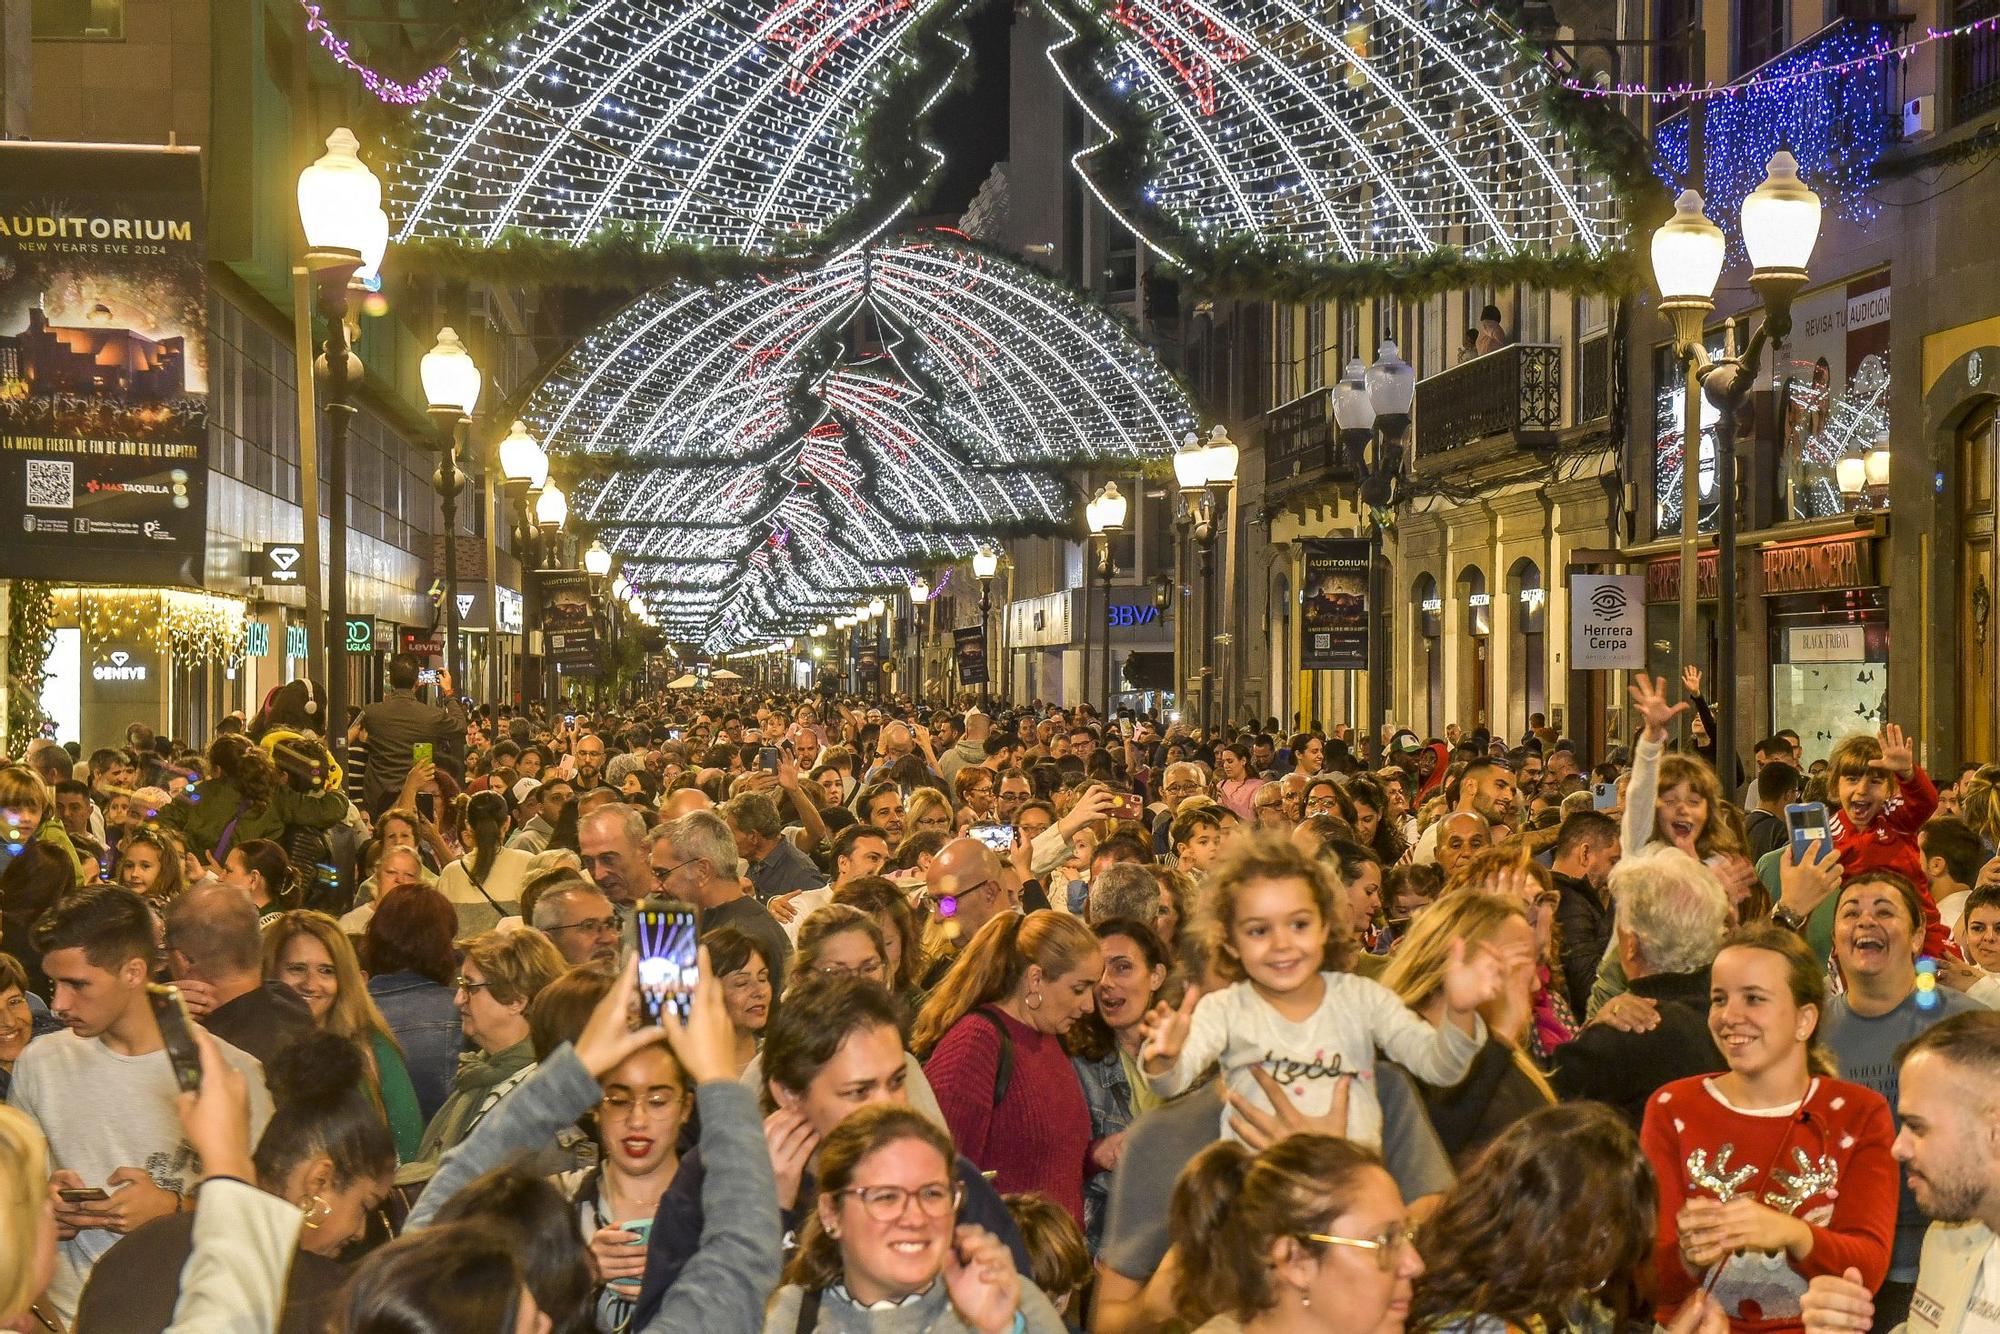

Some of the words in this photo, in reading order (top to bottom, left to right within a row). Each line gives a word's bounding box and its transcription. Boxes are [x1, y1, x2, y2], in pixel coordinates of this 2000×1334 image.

[0, 216, 192, 241] AUDITORIUM
[19, 242, 47, 252] NEW
[54, 243, 98, 253] YEAR'S
[105, 245, 128, 254] EVE
[135, 246, 166, 255] 2024
[1805, 316, 1832, 337] REVISA
[1836, 311, 1846, 328] TU
[1849, 293, 1890, 325] AUDICIÓN
[3, 436, 13, 449] LA
[15, 436, 44, 451] MAYOR
[47, 438, 74, 452] FIESTA
[77, 439, 87, 453] DE
[90, 440, 104, 454] FIN
[106, 441, 117, 455] DE
[120, 439, 136, 456] AÑO
[139, 442, 150, 457] EN
[152, 443, 163, 457] LA
[165, 444, 198, 459] CAPITAL
[1310, 559, 1368, 567] AUDITORIUM
[1584, 624, 1633, 636] Herrera
[1589, 637, 1628, 651] Cerpa
[1802, 633, 1824, 650] BLACK
[1825, 631, 1849, 649] FRIDAY
